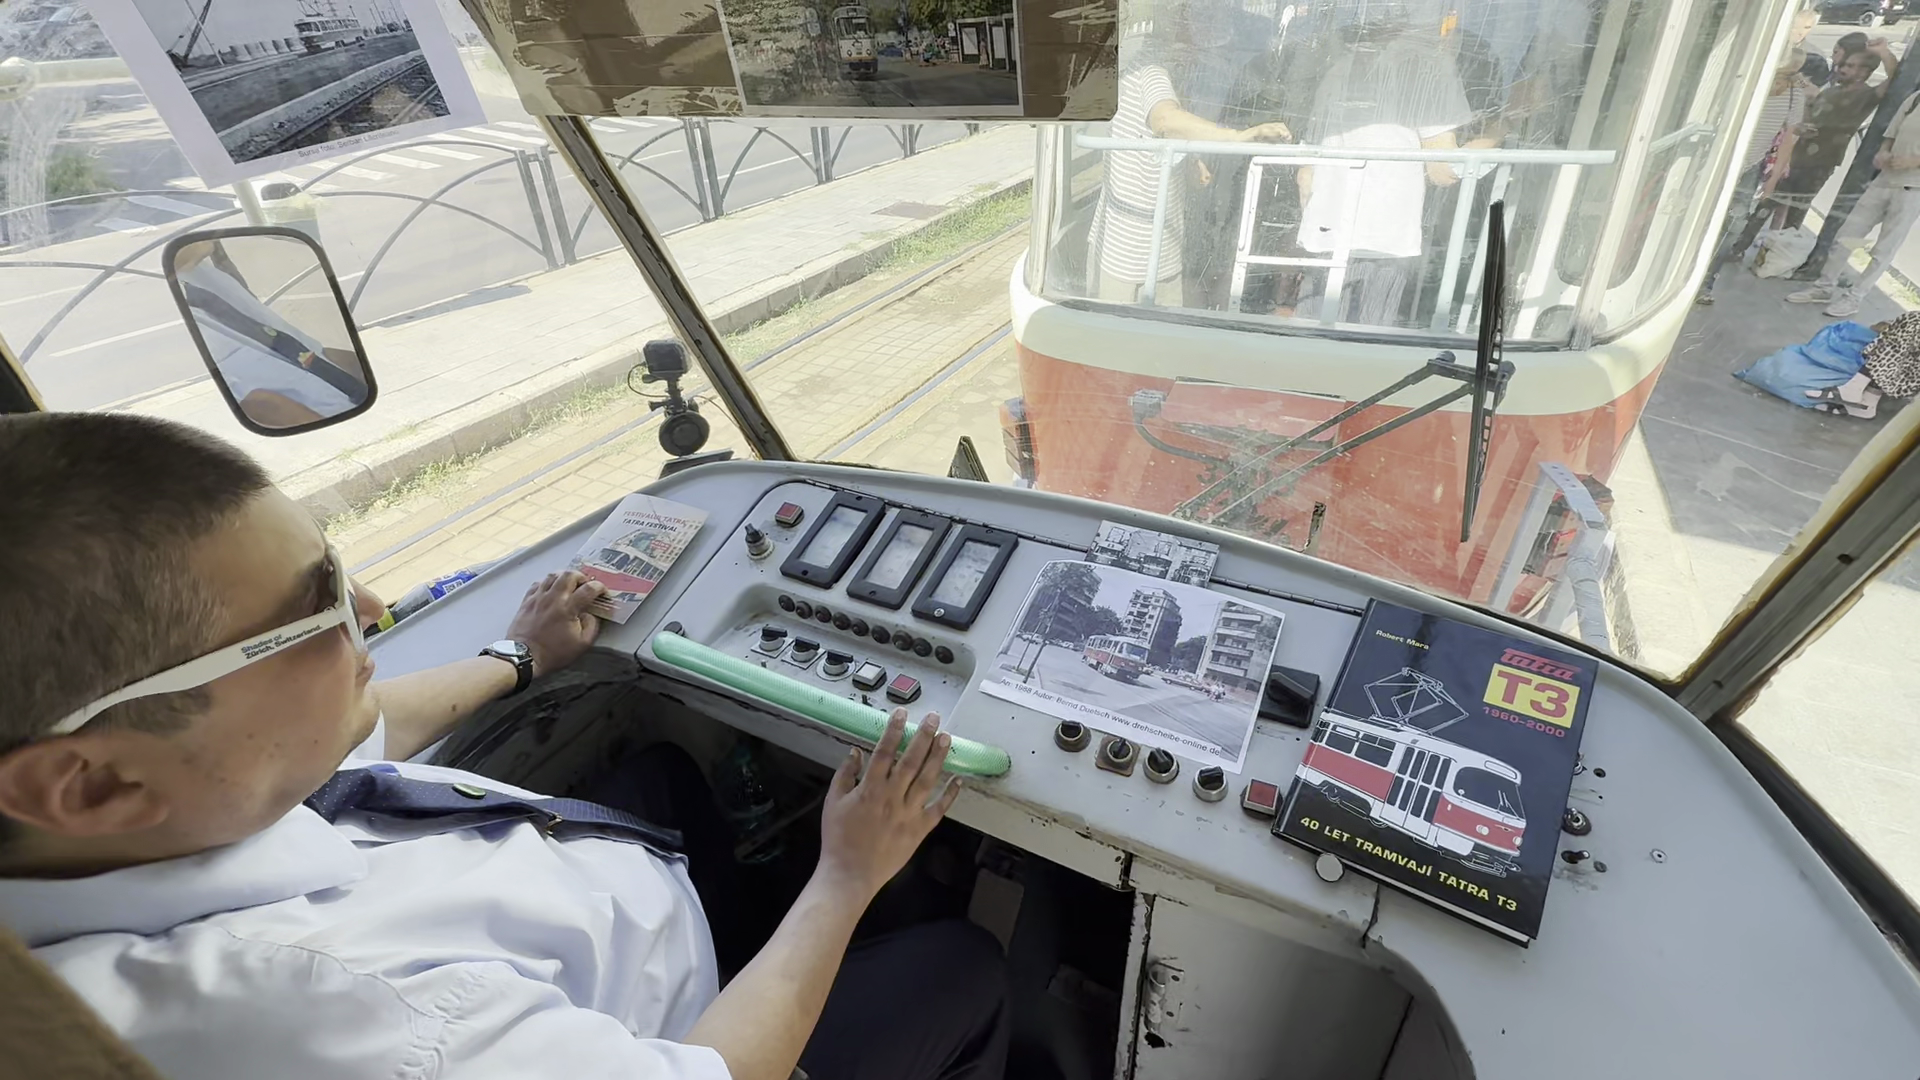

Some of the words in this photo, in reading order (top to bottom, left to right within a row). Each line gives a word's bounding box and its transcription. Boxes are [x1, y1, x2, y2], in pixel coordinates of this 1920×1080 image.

[622, 518, 644, 526] TATRA
[645, 521, 677, 532] FESTIVAL
[663, 516, 686, 526] TATRA
[241, 637, 273, 653] Shades
[273, 634, 282, 642] of
[245, 645, 275, 659] Zürich,
[274, 624, 323, 647] Switzerland.
[1375, 629, 1404, 643] Robert
[1406, 638, 1430, 650] Mara
[1014, 682, 1032, 694] 1988
[1056, 696, 1078, 710] Bernd
[1079, 704, 1110, 719] Duetsch
[1497, 669, 1570, 719] T3
[1482, 706, 1565, 738] 1960-2000
[1300, 816, 1320, 831] 40
[1323, 825, 1352, 843] LET
[1354, 837, 1433, 877] TRAMVAJÍ
[1438, 871, 1489, 901] TATRA
[1496, 894, 1518, 911] T3
